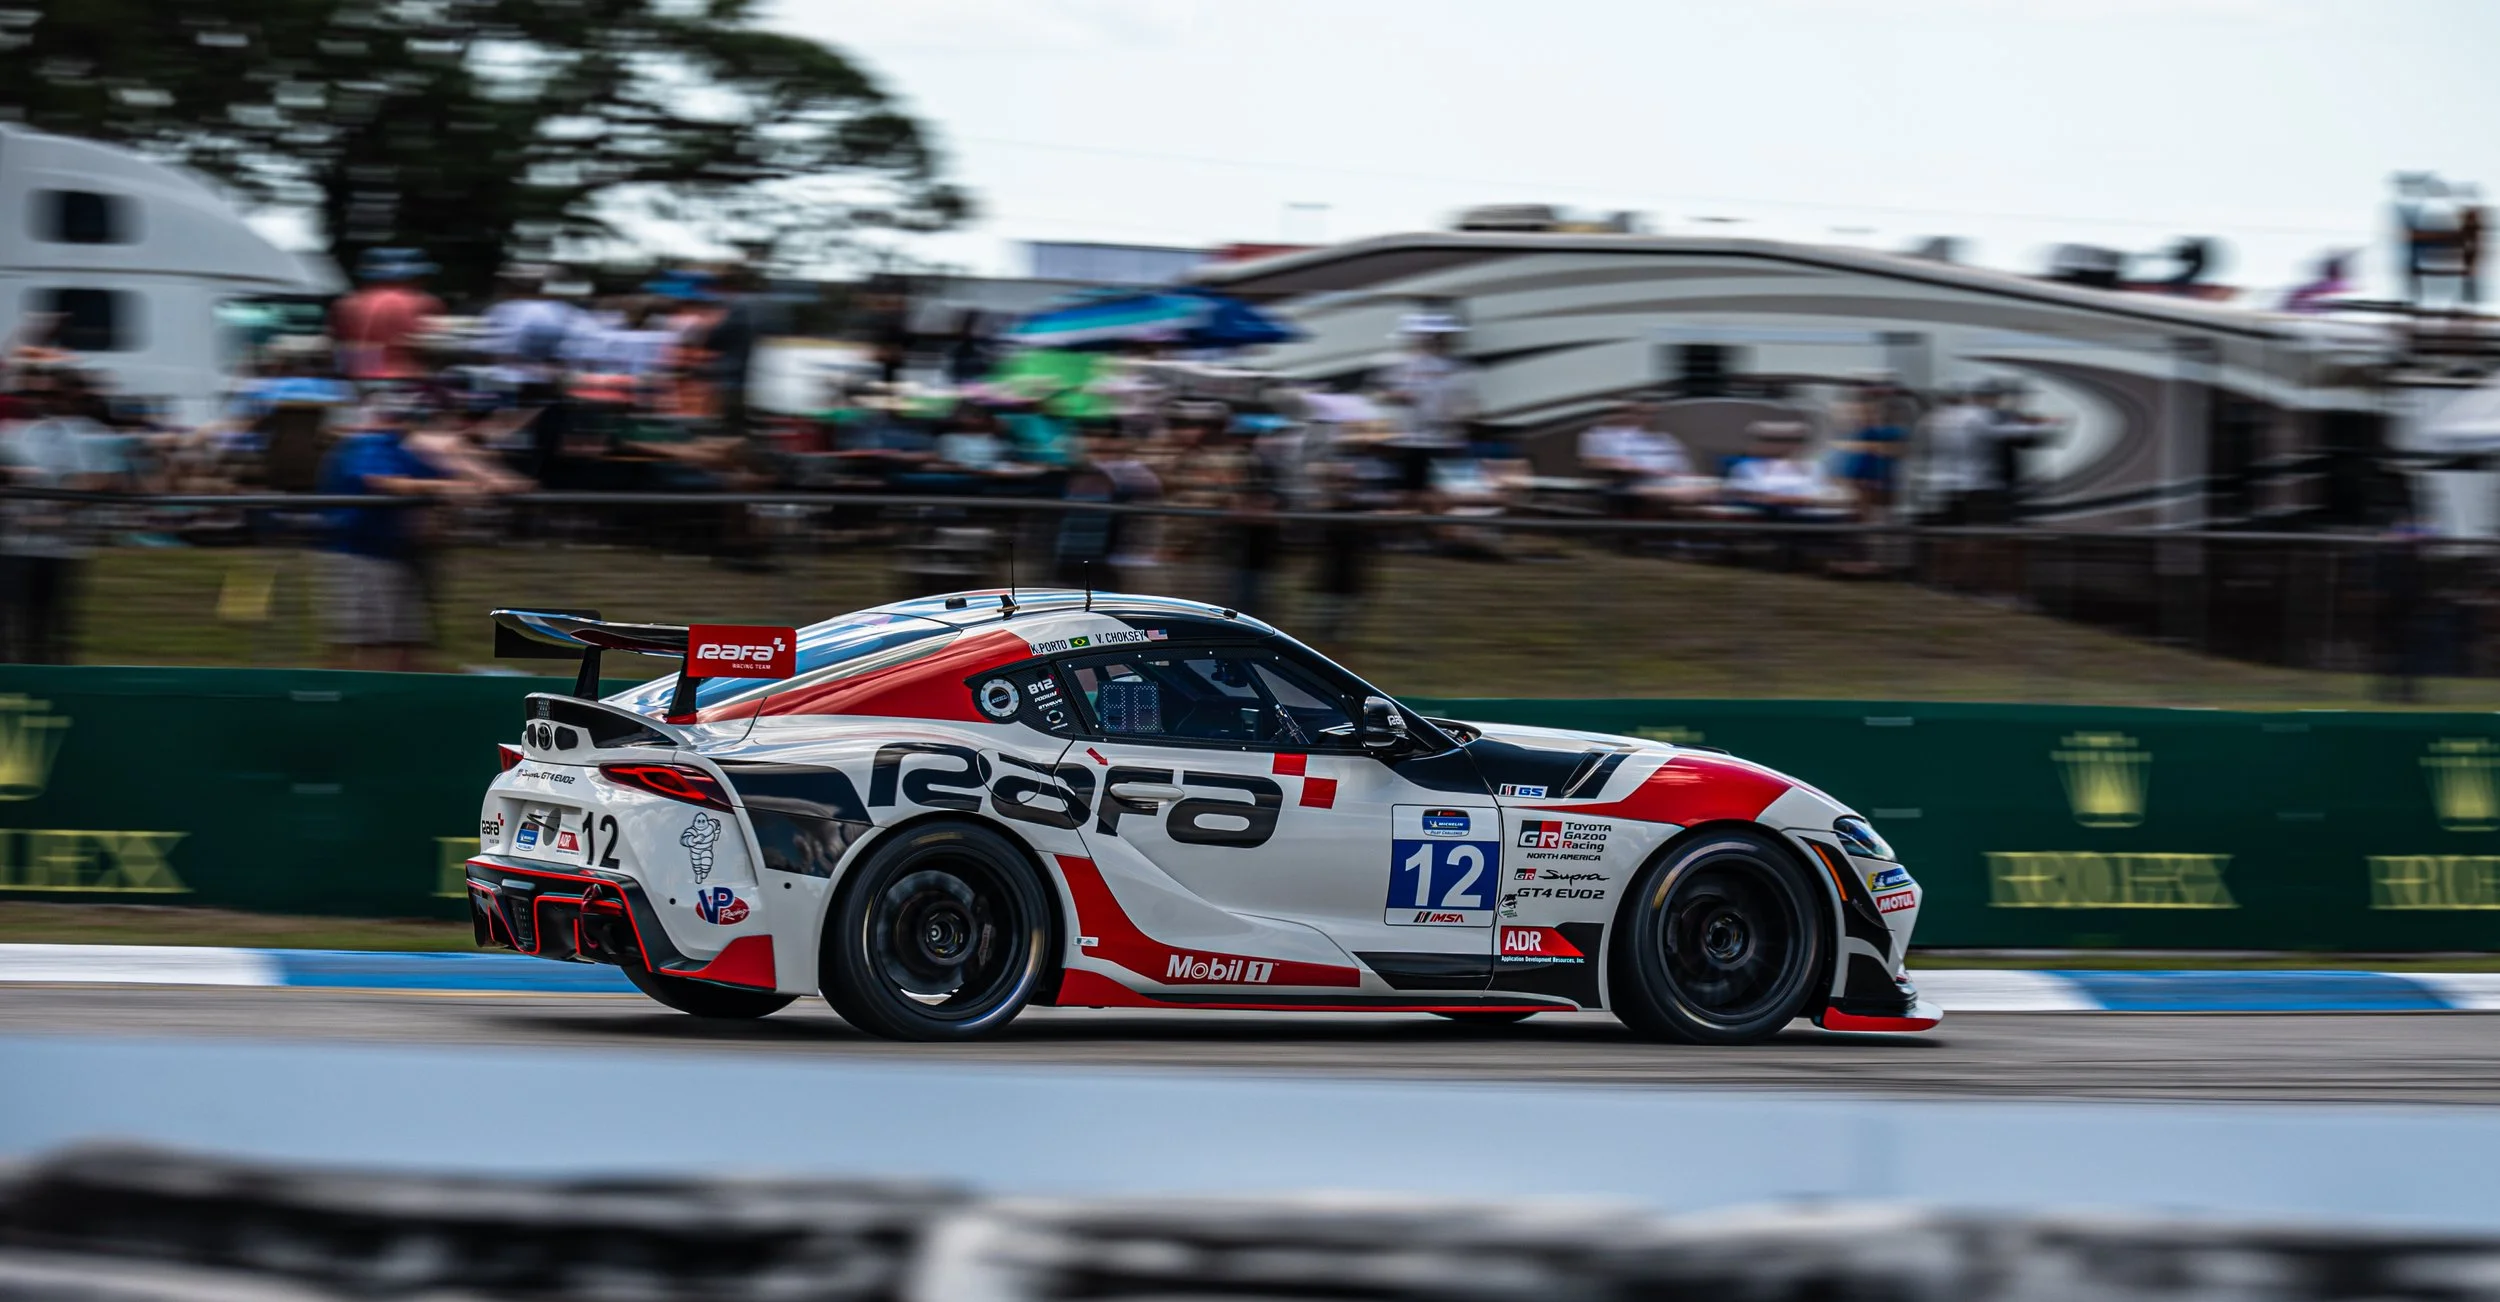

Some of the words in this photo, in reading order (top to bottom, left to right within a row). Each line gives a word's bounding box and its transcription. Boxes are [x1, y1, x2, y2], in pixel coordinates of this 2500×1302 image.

[1095, 633, 1104, 644] V.
[1106, 630, 1145, 643] CHOKSEY
[1518, 787, 1544, 797] GS
[1565, 822, 1612, 832] TOYOTA
[583, 811, 620, 869] 12
[1519, 831, 1560, 848] GR
[1563, 832, 1607, 841] GAZOO
[1562, 841, 1605, 853] Racing
[1526, 852, 1559, 860] NORTH
[1405, 843, 1485, 908] 12
[1514, 872, 1535, 880] GR
[1538, 869, 1610, 887] Supra
[1517, 888, 1552, 898] GT4
[1555, 889, 1605, 900] EVO2
[698, 886, 734, 925] VP
[1880, 893, 1915, 911] MOTUL
[721, 908, 749, 922] Racing
[1430, 913, 1464, 923] IMSA
[1505, 930, 1542, 951] ADR
[1166, 954, 1243, 982] Mobil
